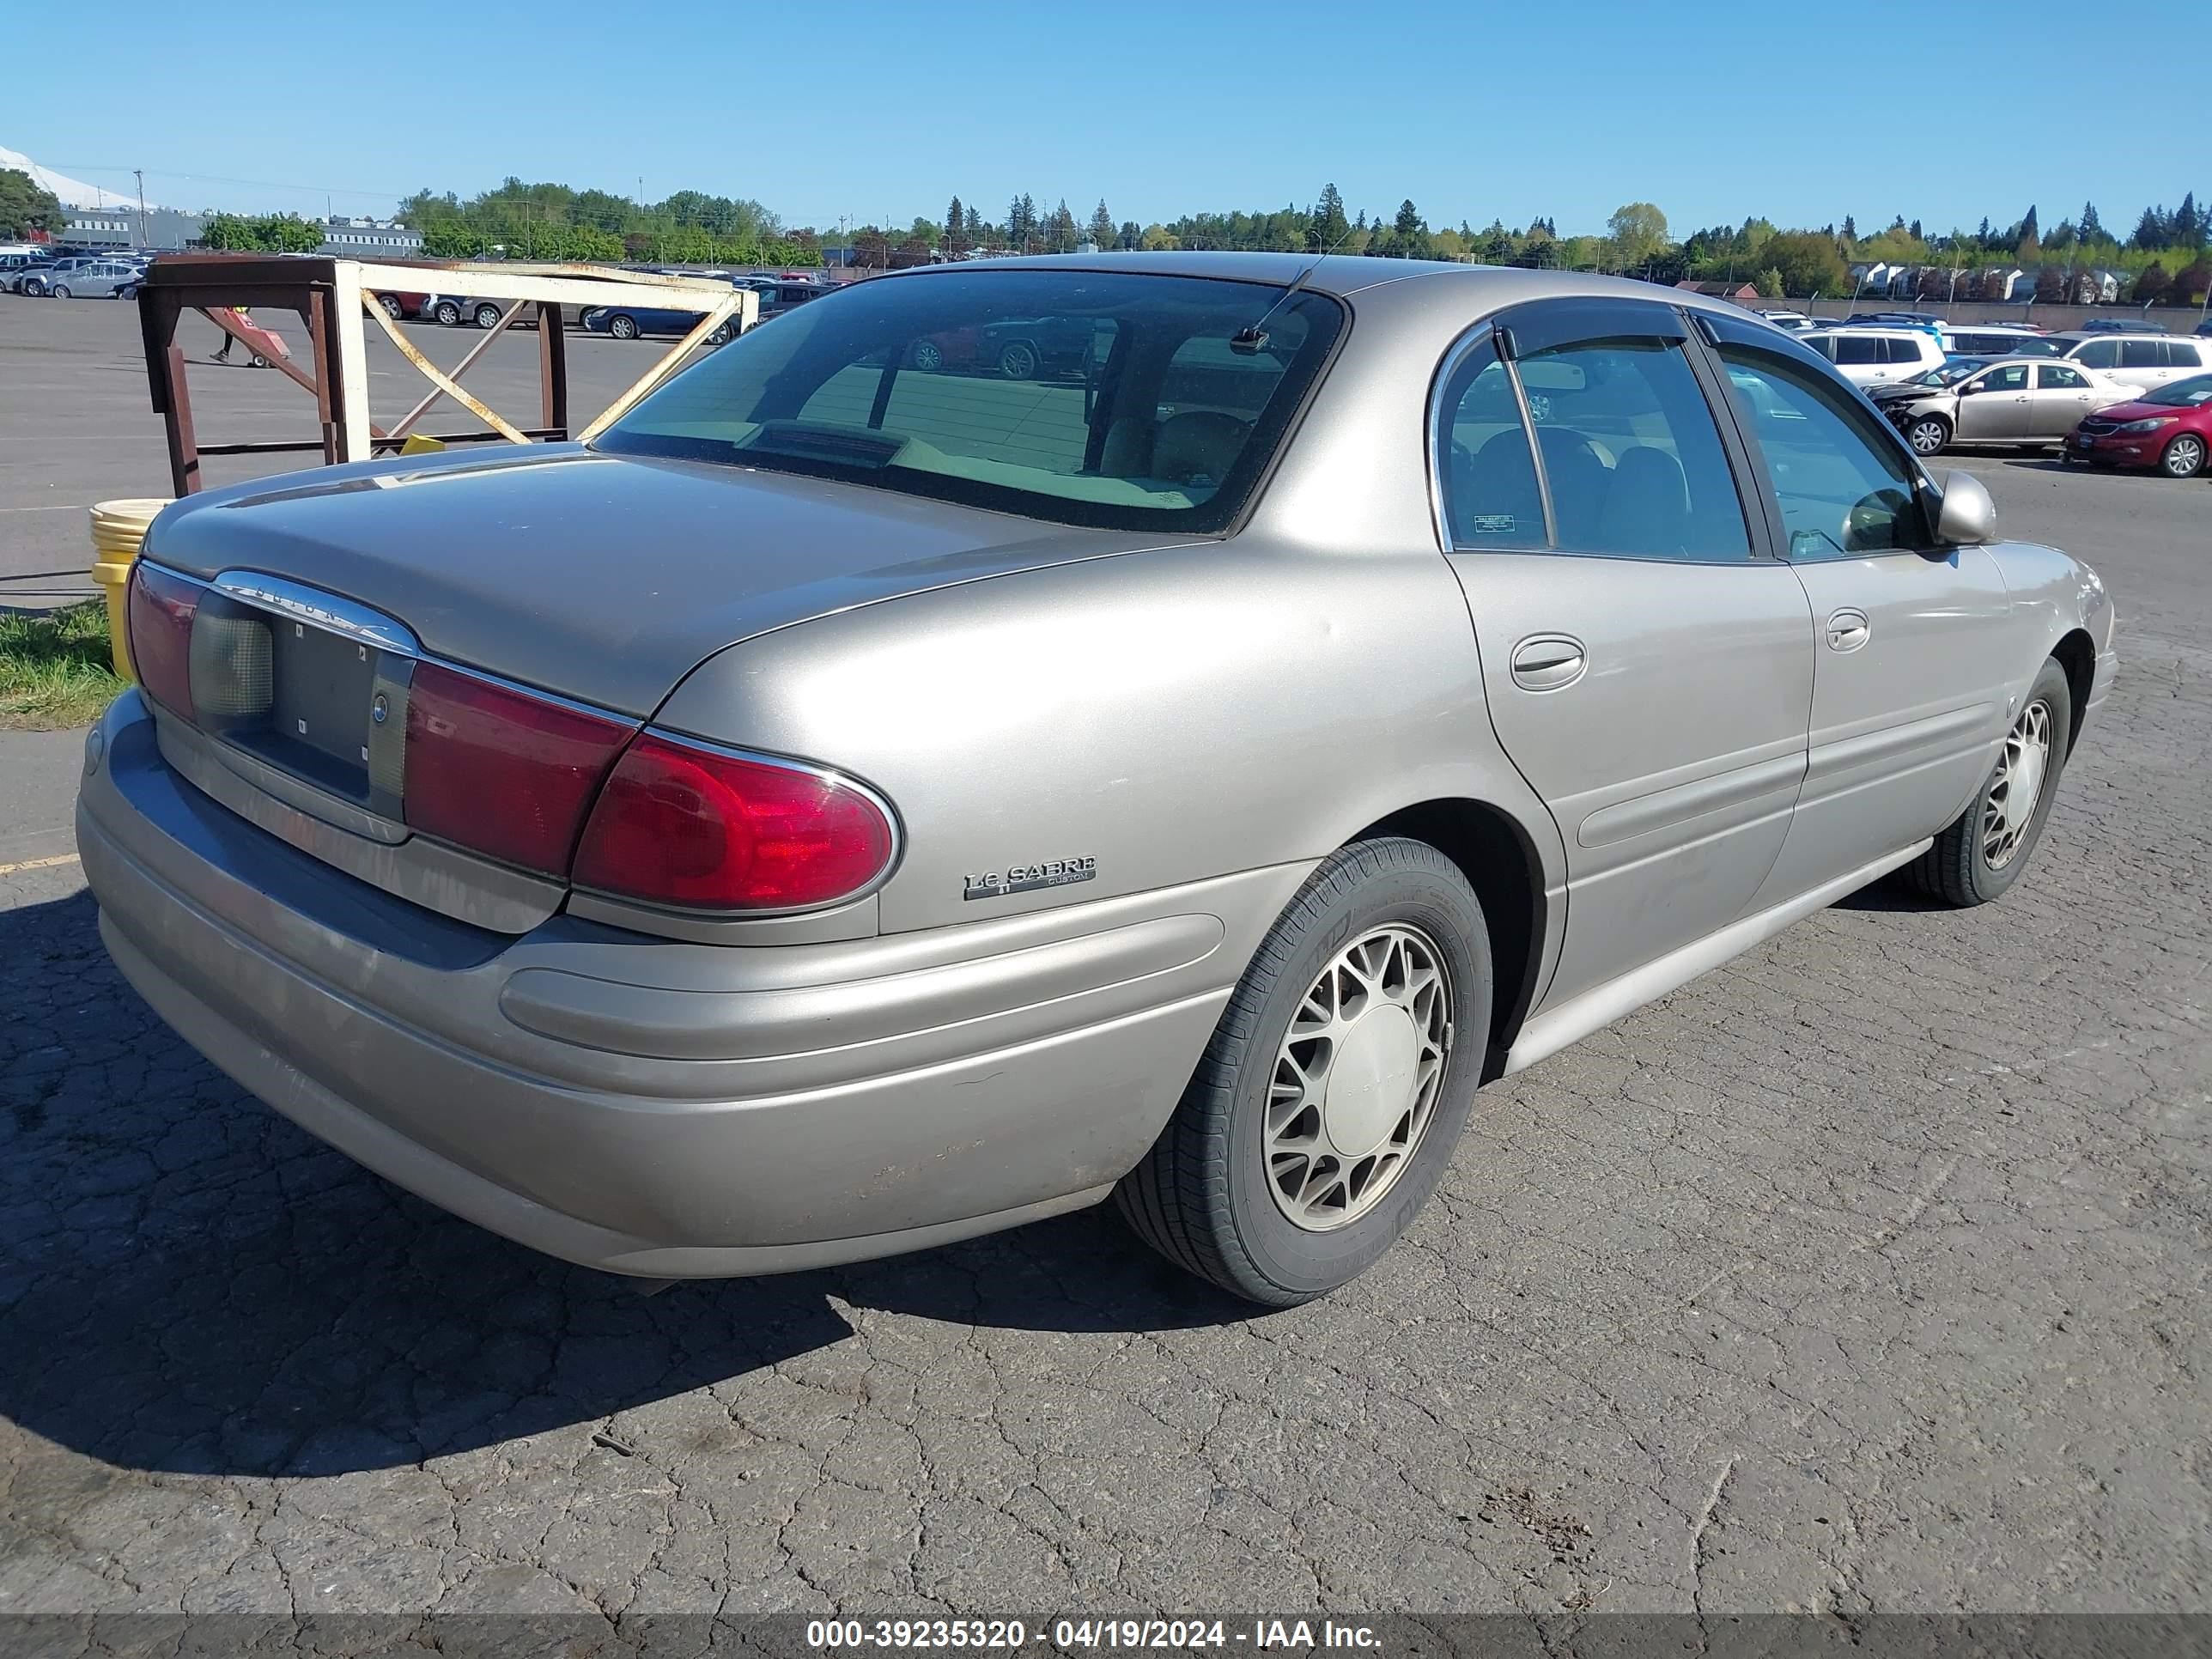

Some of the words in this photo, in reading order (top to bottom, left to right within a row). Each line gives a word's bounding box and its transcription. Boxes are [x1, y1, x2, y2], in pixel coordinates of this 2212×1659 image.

[964, 872, 1000, 890] Le
[1008, 855, 1097, 883] SABRE
[1048, 872, 1088, 885] CUSTOM
